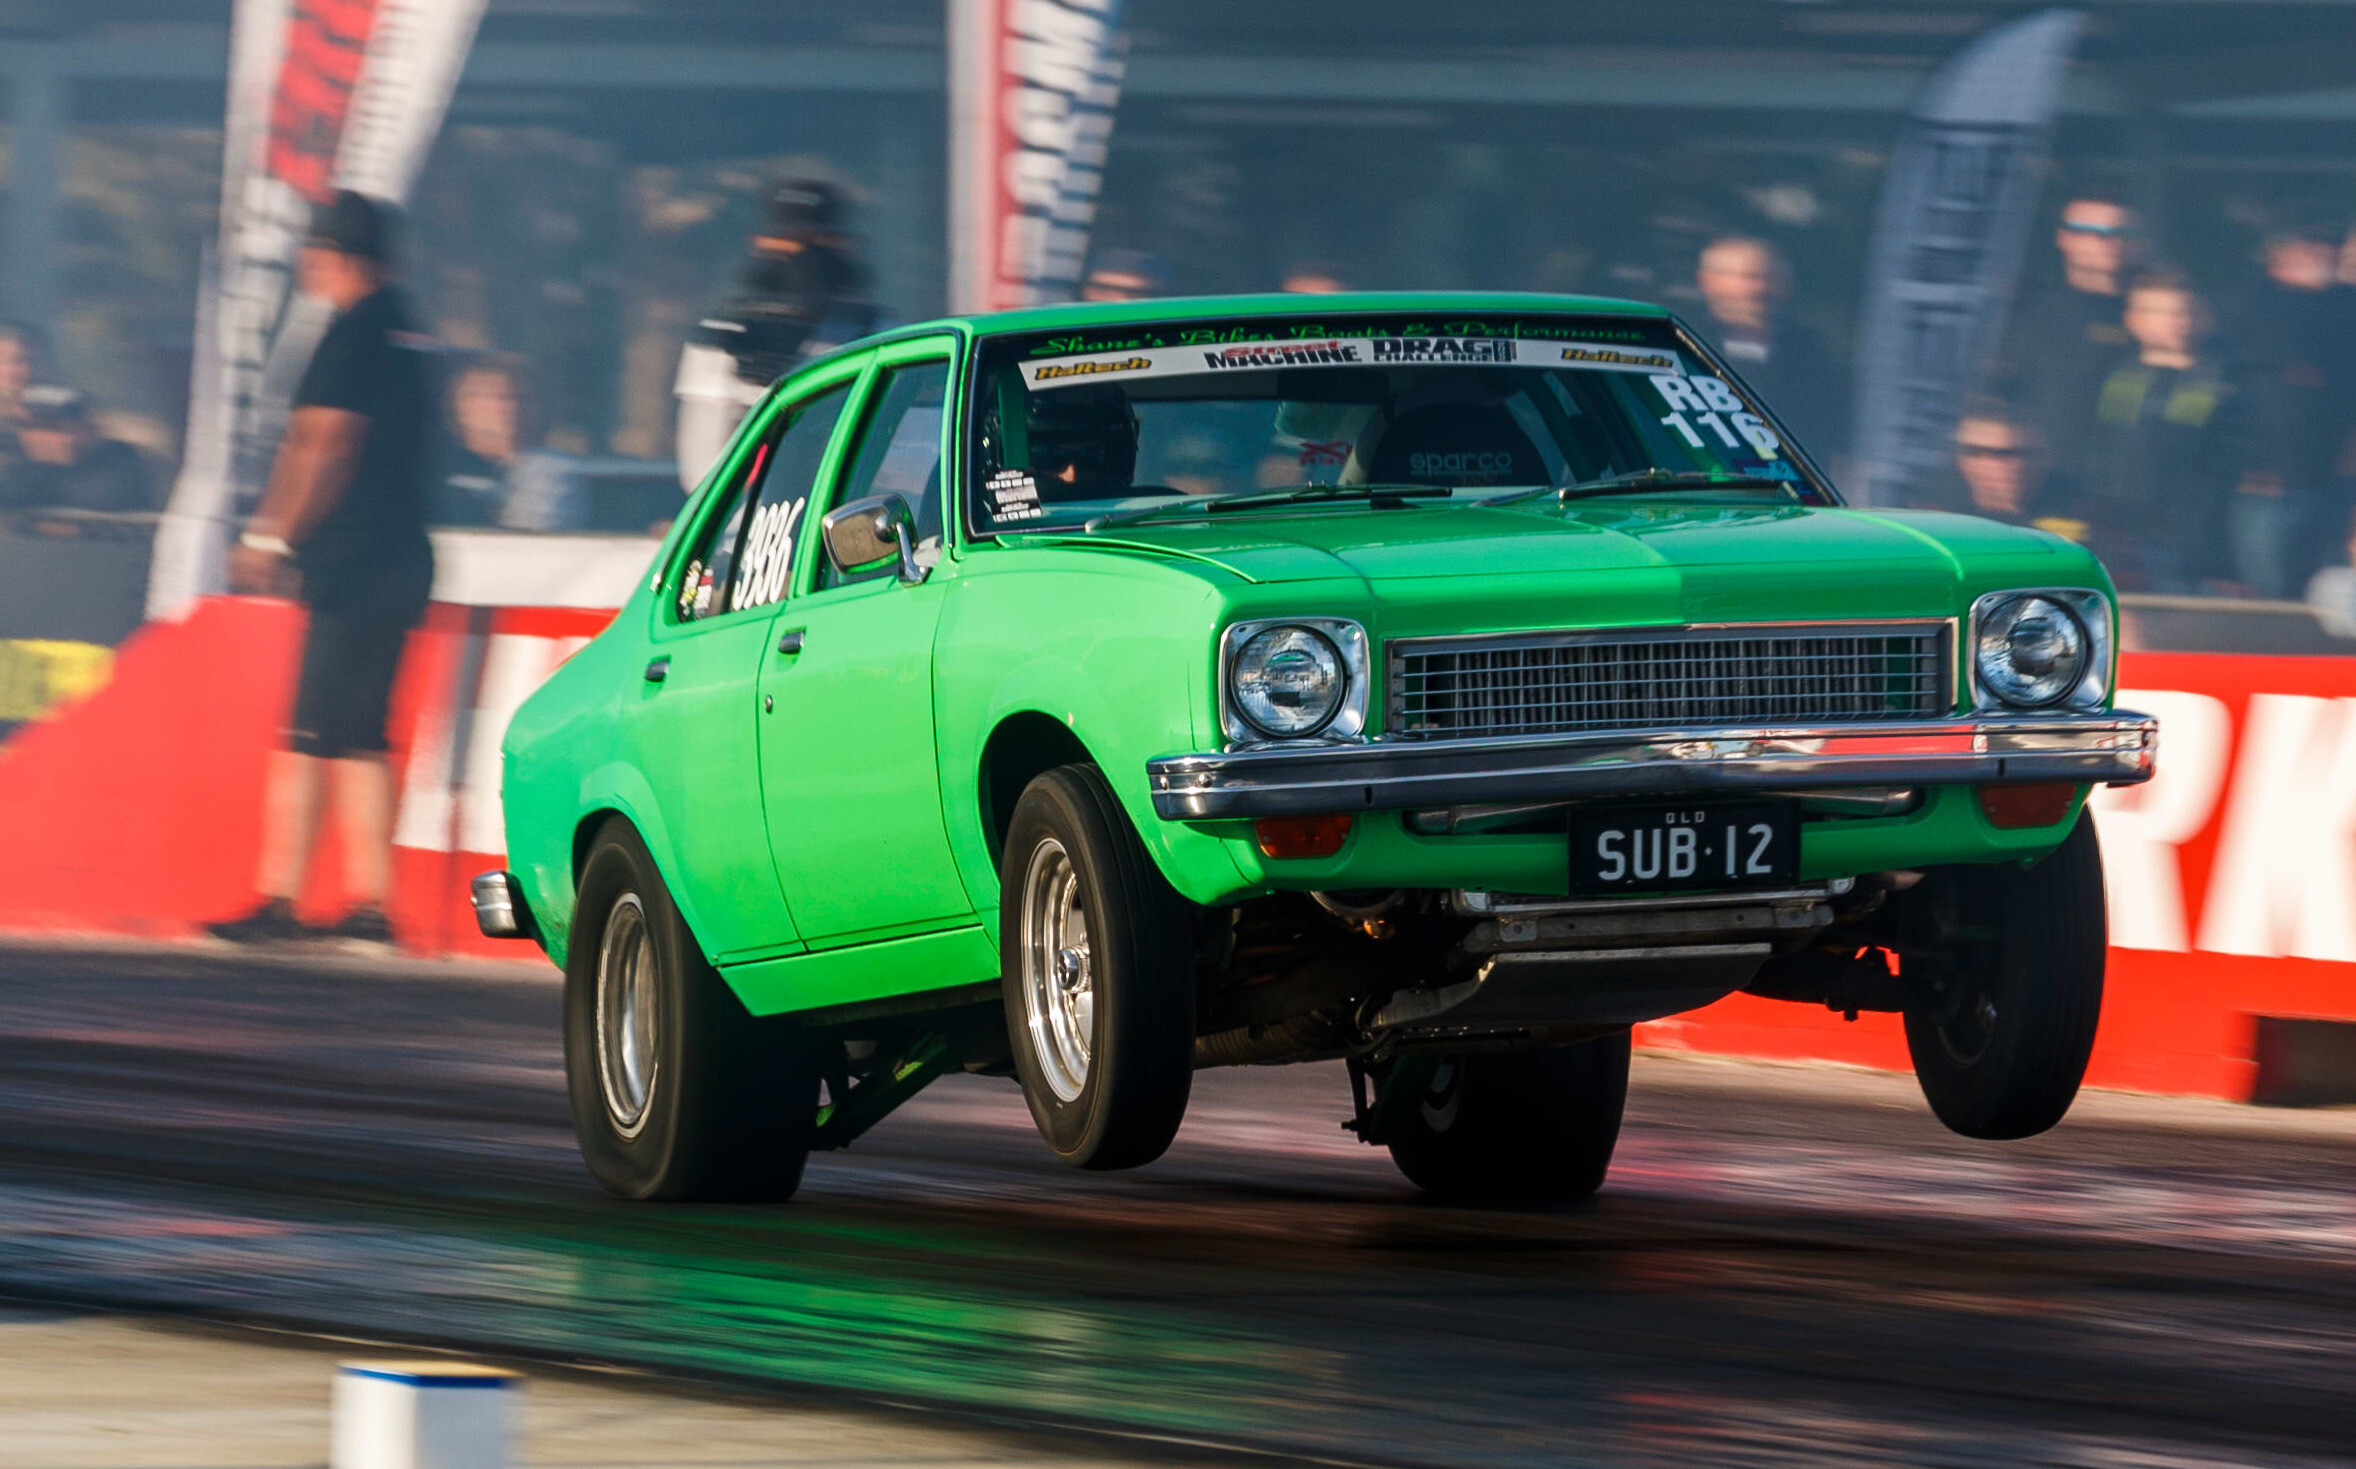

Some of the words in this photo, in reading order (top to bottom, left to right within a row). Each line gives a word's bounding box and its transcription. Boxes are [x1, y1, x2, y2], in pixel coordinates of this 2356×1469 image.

[1030, 332, 1165, 355] Shane's
[1179, 326, 1275, 345] Bikes
[1289, 325, 1388, 339] Boats
[1402, 323, 1434, 338] &
[1444, 321, 1647, 340] Performance
[1372, 339, 1493, 354] DRAG
[1034, 357, 1152, 381] Haltech
[1203, 345, 1363, 369] MACHINE
[1561, 347, 1674, 368] Haltech
[1648, 374, 1744, 412] RB
[1660, 411, 1780, 450] 116
[1409, 451, 1513, 479] sparco
[1665, 810, 1705, 825] QLD
